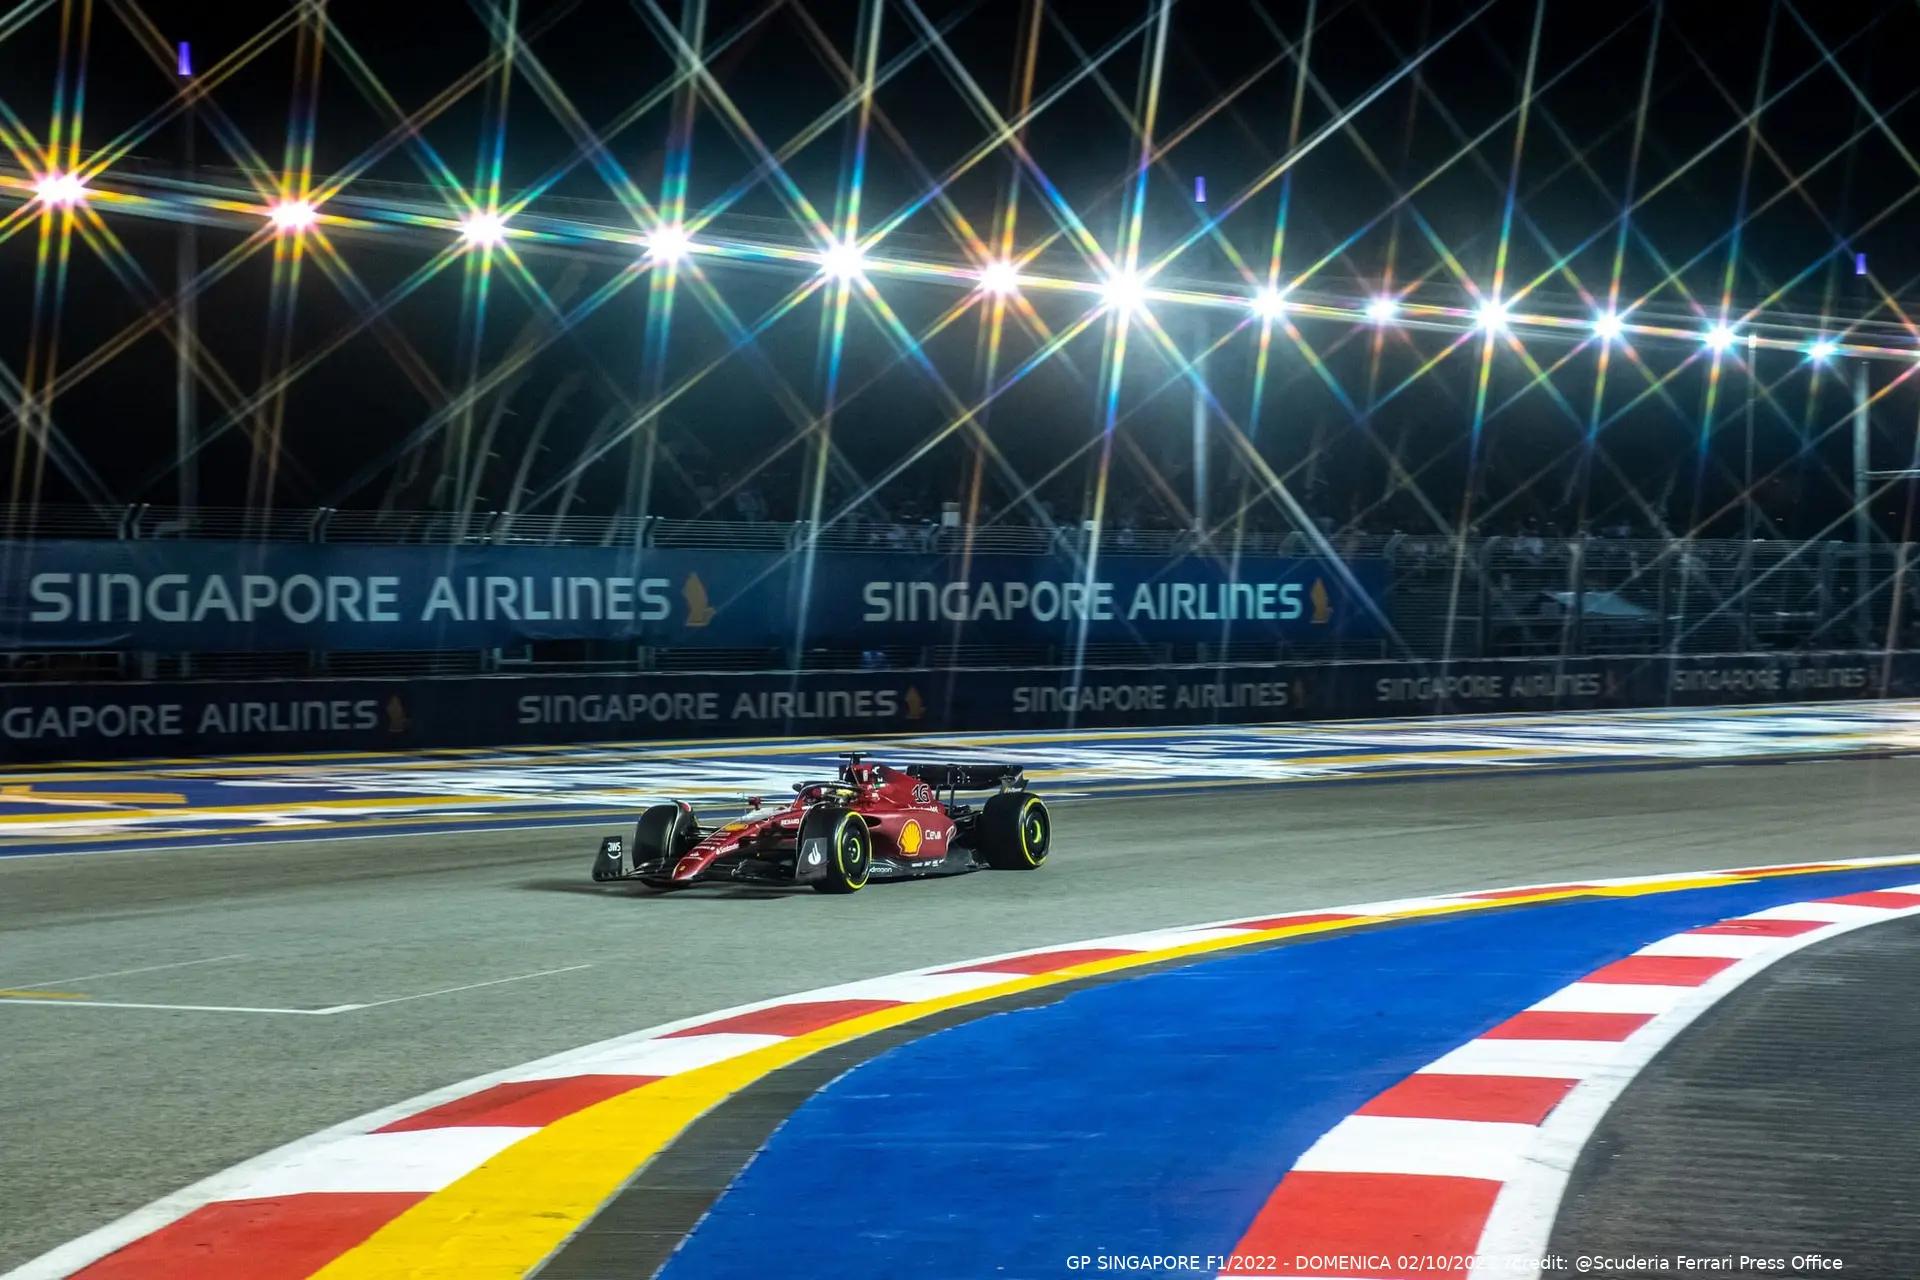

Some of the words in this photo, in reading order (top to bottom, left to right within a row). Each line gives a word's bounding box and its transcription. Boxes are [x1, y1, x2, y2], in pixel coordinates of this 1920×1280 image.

[29, 572, 400, 624] SINGAPORE
[421, 576, 672, 622] AIRLINES
[862, 580, 1114, 623] SINGAPORE
[1127, 582, 1303, 621] AIRLINES
[1012, 683, 1166, 713] SINGAPORE
[1174, 681, 1288, 709] AIRLINES
[1376, 675, 1502, 701] SINGAPORE
[1511, 673, 1601, 697] AIRLINES
[1673, 668, 1781, 692] SINGAPORE
[1787, 667, 1866, 689] AIRLINES
[1, 703, 183, 739] GAPORE
[198, 699, 379, 734] AIRLINES
[518, 692, 717, 726] SINGAPORE
[731, 688, 898, 719] AIRLINES
[912, 783, 931, 804] 16
